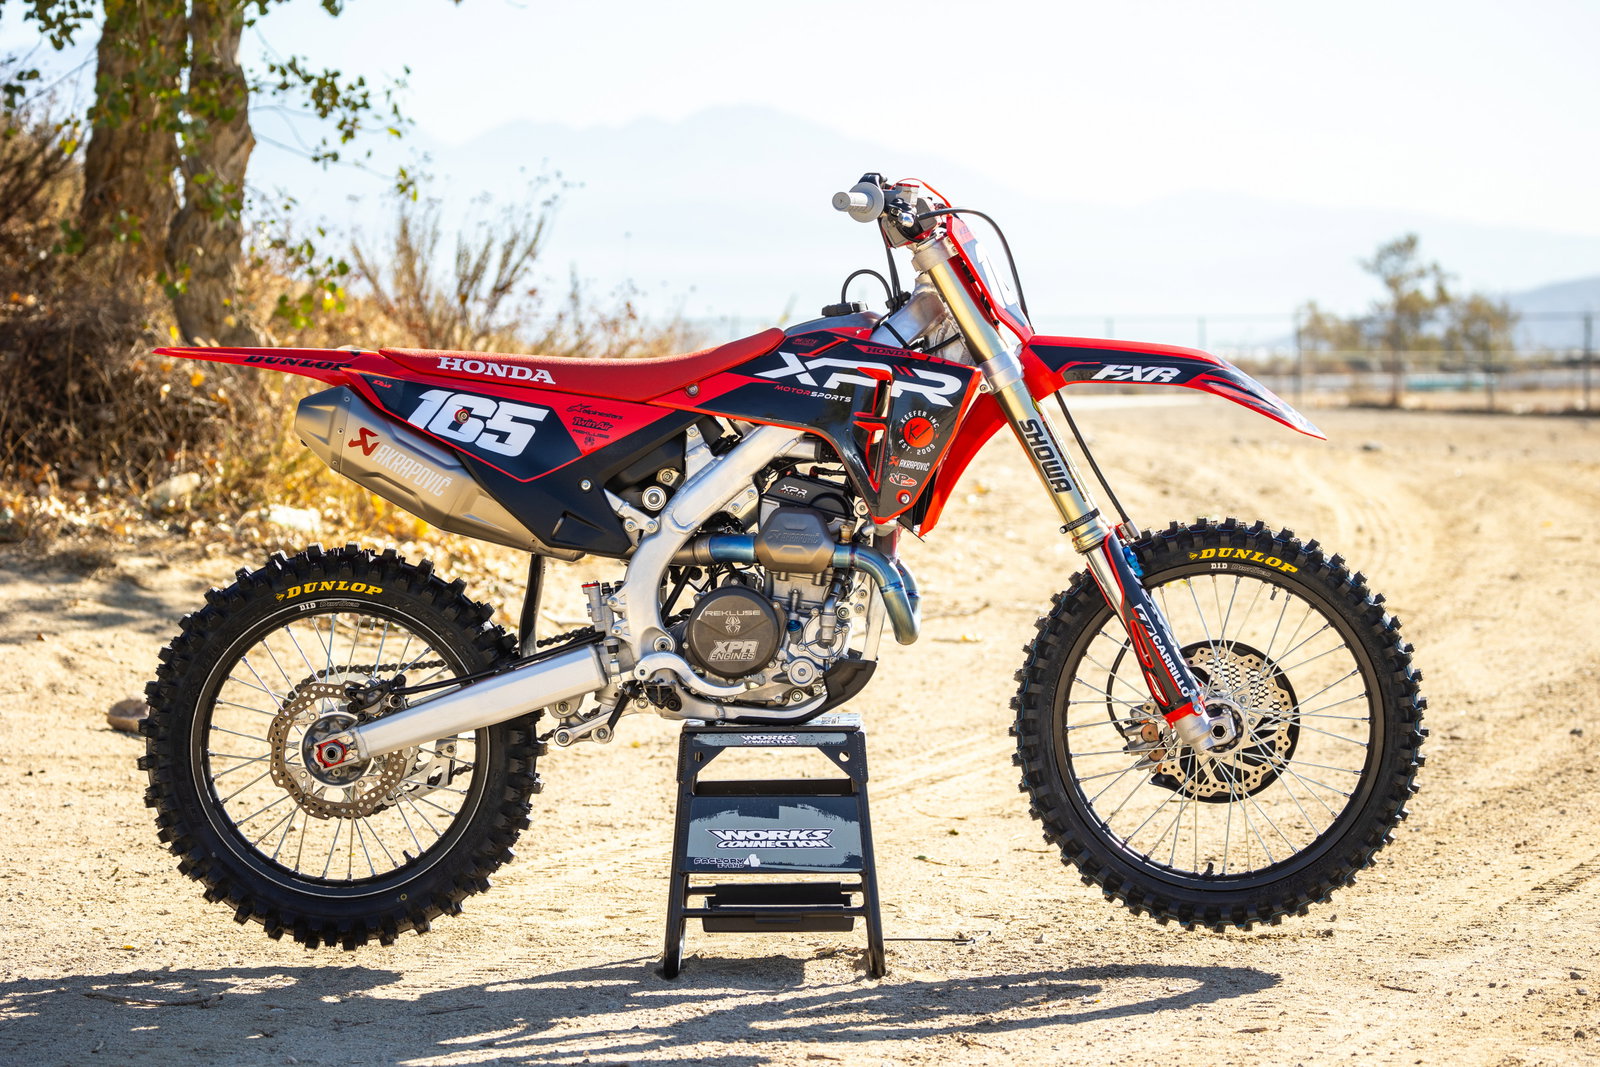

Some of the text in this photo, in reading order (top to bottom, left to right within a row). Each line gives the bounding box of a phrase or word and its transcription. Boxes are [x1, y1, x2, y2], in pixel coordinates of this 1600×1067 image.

[866, 347, 913, 357] HONDA
[244, 355, 353, 371] DUNLOP
[437, 356, 556, 385] HONDA
[754, 351, 962, 408] XPR
[1091, 364, 1181, 383] FXR
[774, 385, 852, 403] MOTORSPORTS
[407, 389, 549, 457] 165
[900, 410, 927, 424] KEEFER
[916, 443, 936, 455] 2009
[1019, 418, 1073, 494] SHOWA
[780, 484, 808, 497] XPR
[1199, 547, 1298, 573] DUNLOP
[286, 580, 383, 599] DUNLOP
[710, 652, 755, 660] ENGINES
[711, 641, 758, 654] XPR
[1152, 635, 1191, 698] CARRILLO
[707, 829, 834, 840] WORKS
[716, 840, 834, 848] CONNECTION
